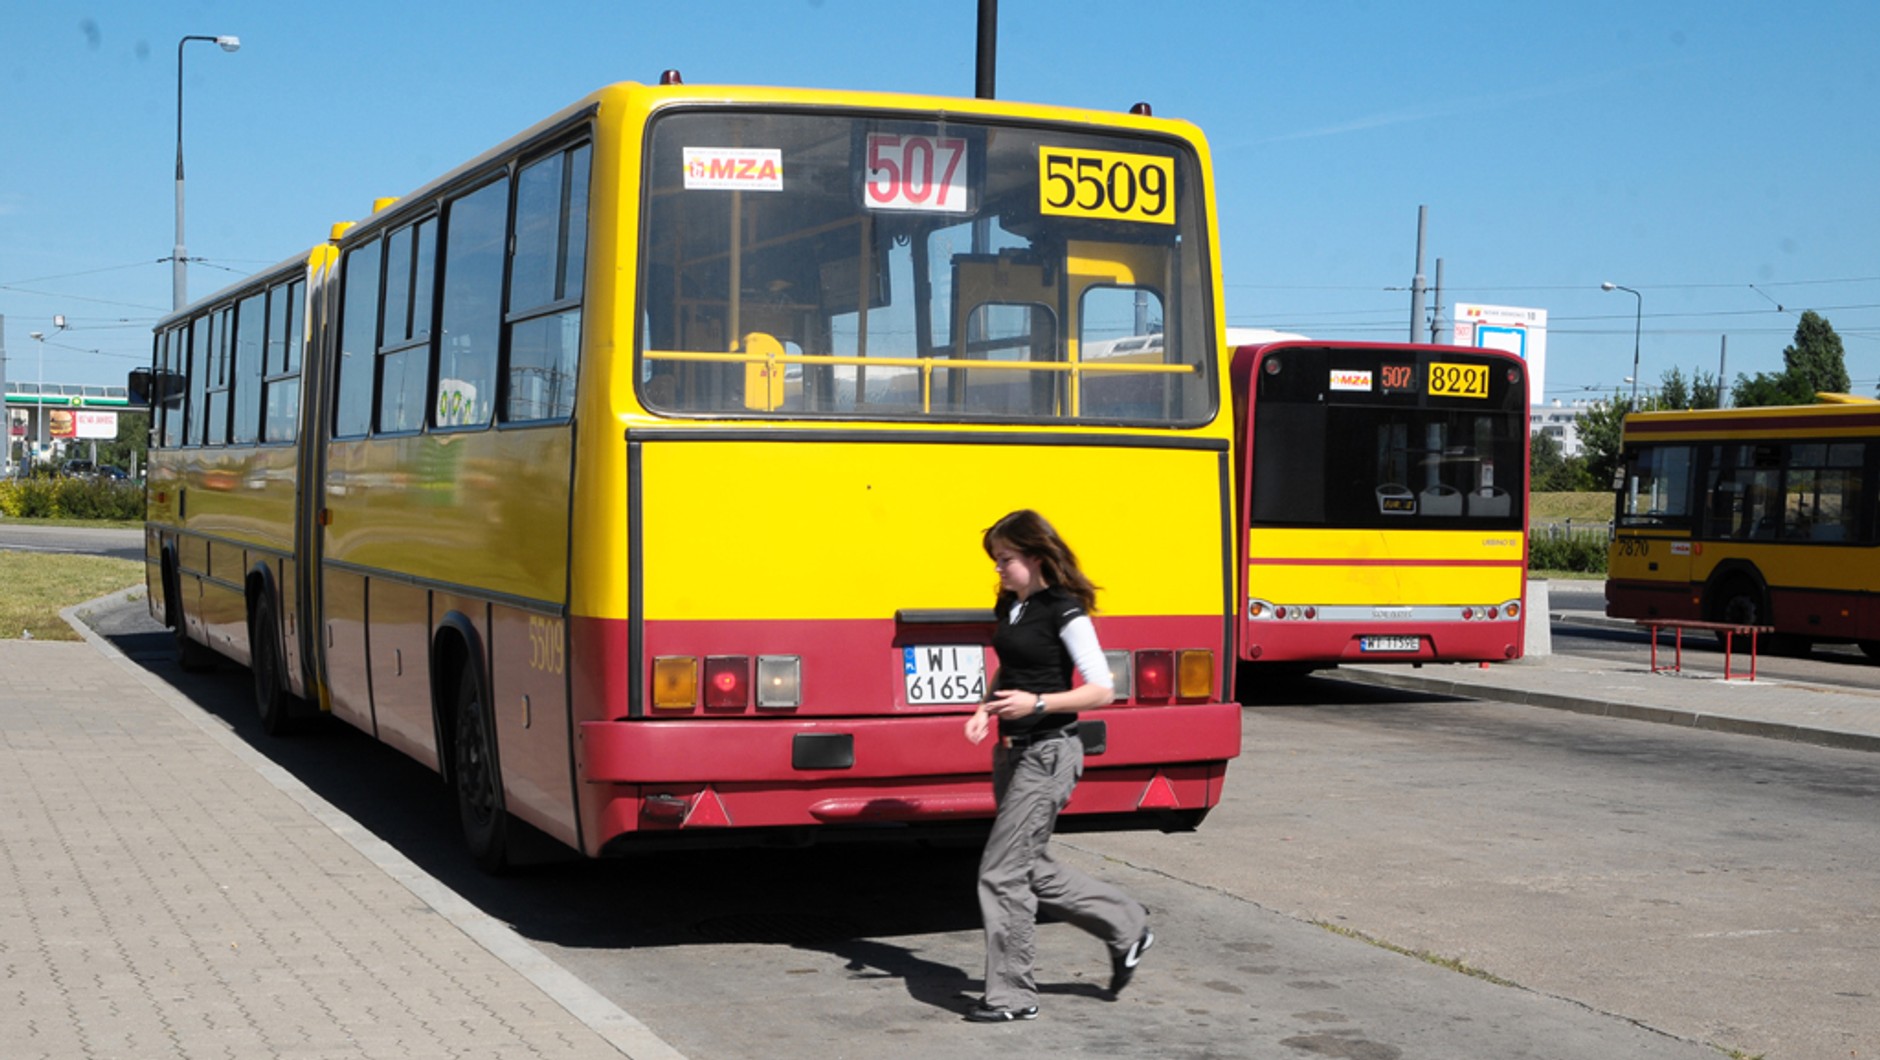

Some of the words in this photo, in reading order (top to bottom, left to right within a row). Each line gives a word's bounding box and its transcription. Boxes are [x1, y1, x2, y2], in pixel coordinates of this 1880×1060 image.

[708, 158, 778, 180] MZA
[867, 136, 966, 206] 507
[1046, 153, 1168, 217] 5509
[1341, 375, 1369, 385] MZA
[1382, 365, 1412, 388] 507
[1431, 366, 1487, 394] 8221
[1618, 540, 1650, 557] 7870
[529, 615, 564, 674] 5509
[927, 648, 959, 672] WI
[910, 675, 985, 701] 61654
